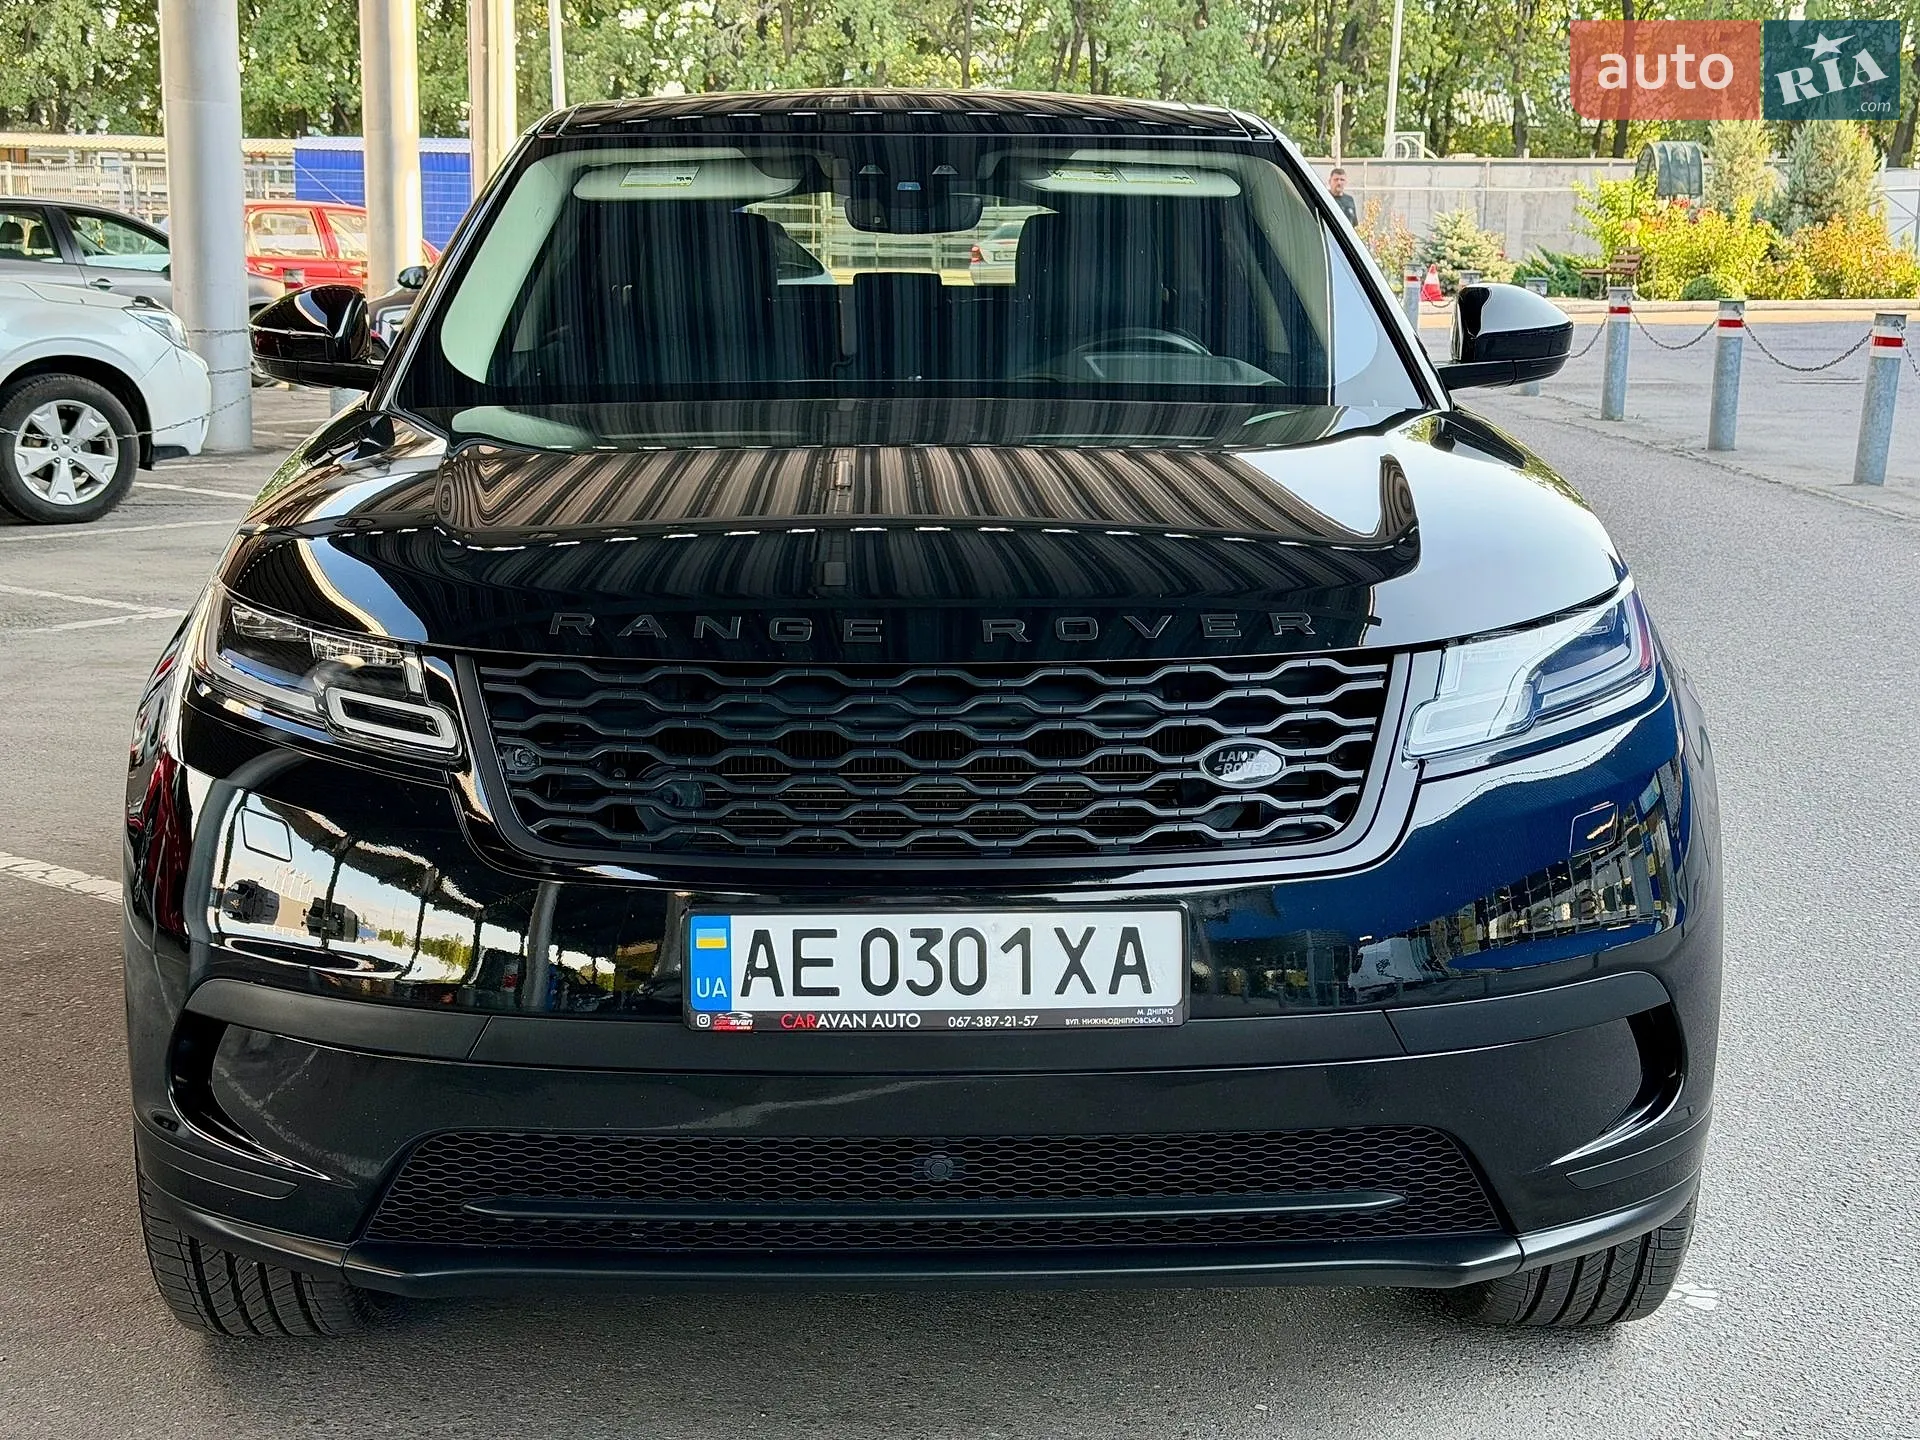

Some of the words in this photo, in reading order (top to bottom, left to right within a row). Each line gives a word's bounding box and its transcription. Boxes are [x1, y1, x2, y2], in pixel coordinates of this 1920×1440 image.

[549, 612, 883, 643] RANGE
[982, 611, 1316, 643] ROVER
[1218, 751, 1258, 762] LAND
[1222, 763, 1270, 775] ROVER
[740, 928, 840, 997] AE
[860, 927, 1033, 997] 0301
[1055, 926, 1153, 996] XA
[696, 978, 728, 998] UA
[1146, 1008, 1174, 1016] ДНІПРО
[780, 1013, 866, 1029] CARAVAN
[871, 1013, 921, 1028] AUTO
[948, 1015, 1039, 1028] 067-387-21-57
[1166, 1016, 1174, 1024] 15
